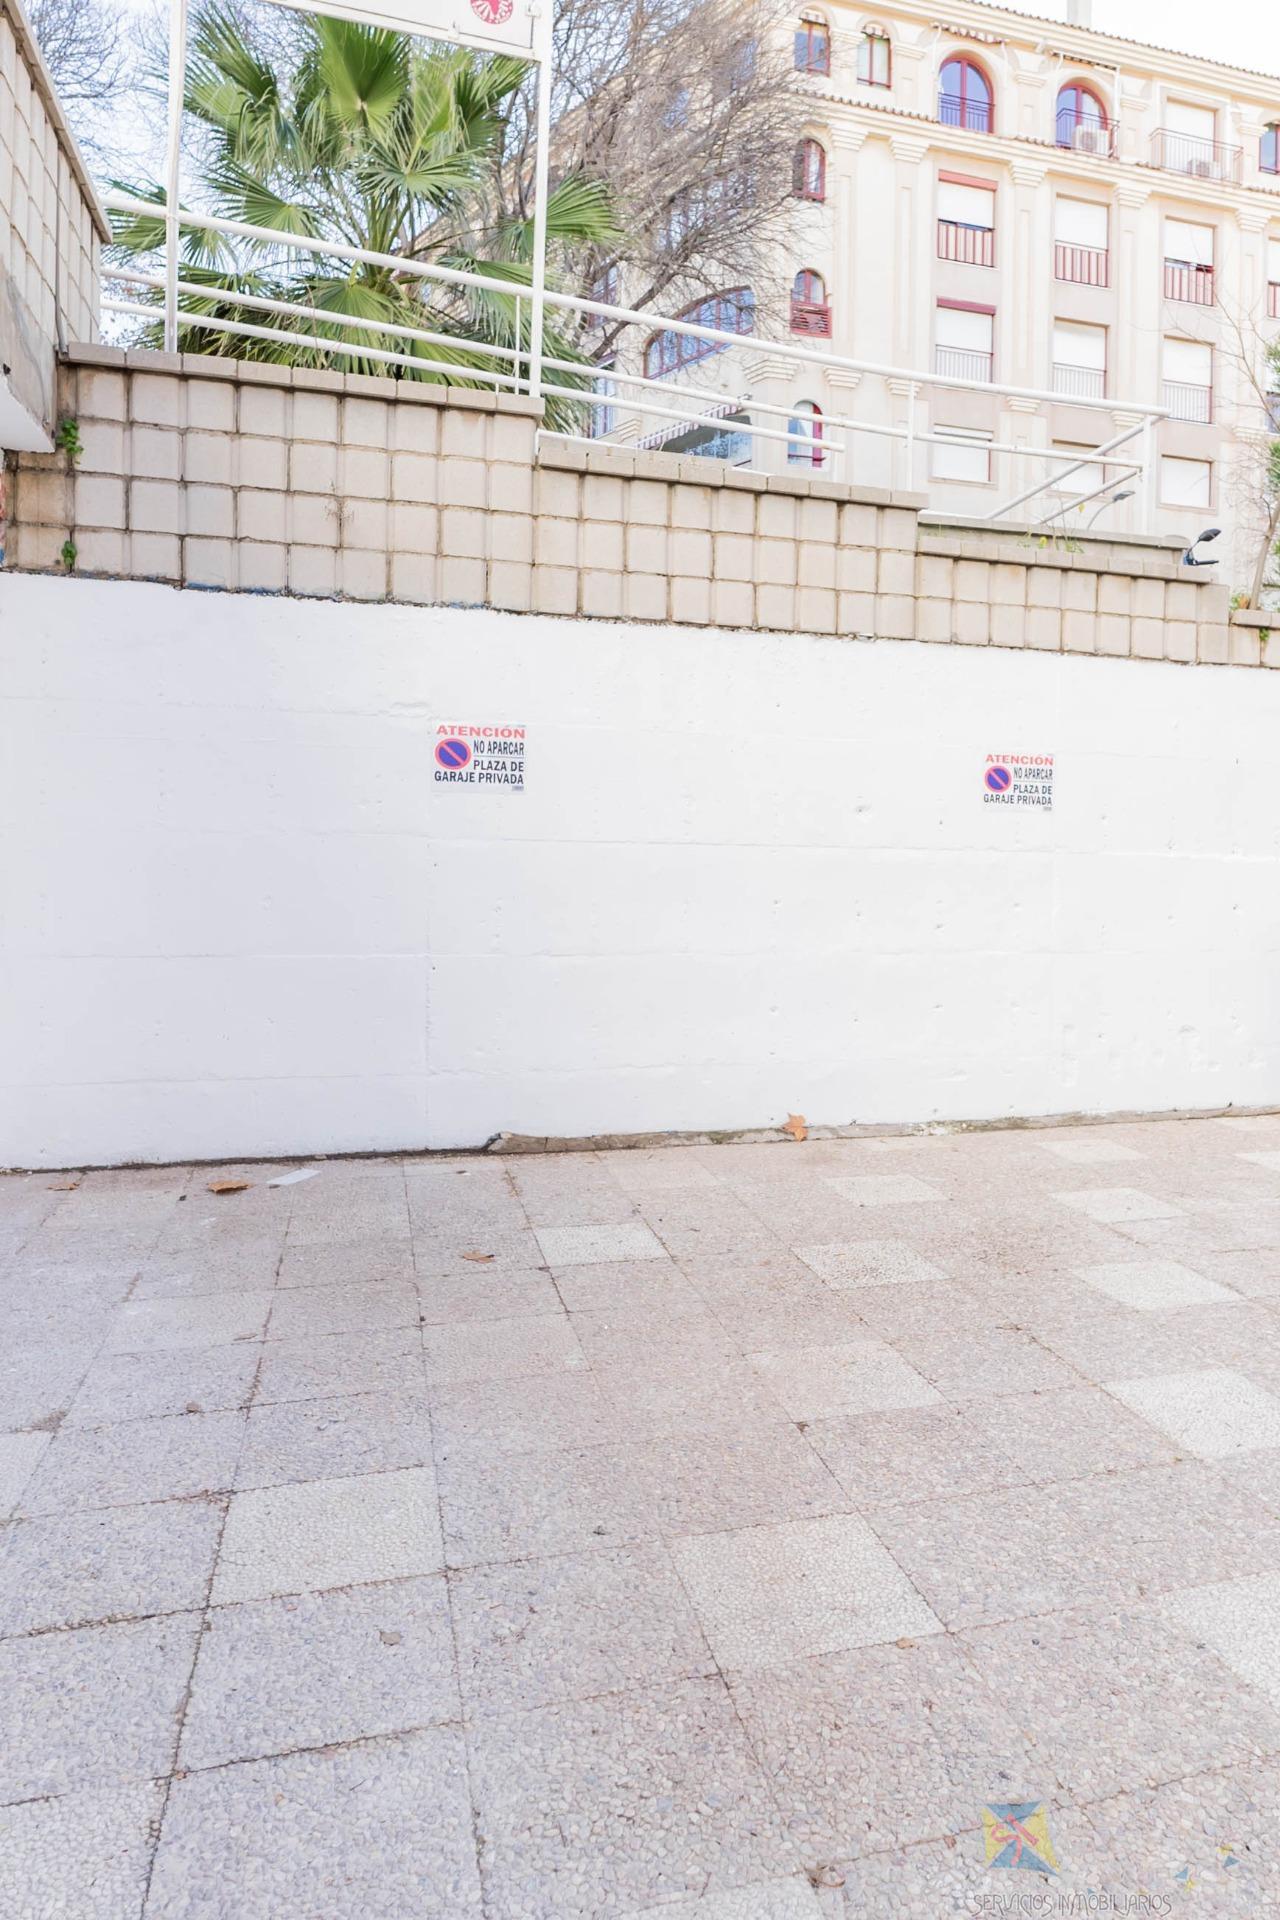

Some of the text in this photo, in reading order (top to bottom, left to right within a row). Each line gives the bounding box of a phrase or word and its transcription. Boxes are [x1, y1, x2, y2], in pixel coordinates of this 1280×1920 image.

[473, 740, 525, 756] NO APARCAR
[473, 759, 525, 772] PLAZA DE
[434, 770, 524, 785] GARAJE PRIVADA
[1013, 767, 1053, 780] NO APARCAR
[1013, 784, 1053, 795] PLAZA DE
[983, 793, 1053, 806] GARAJE PRIVADA
